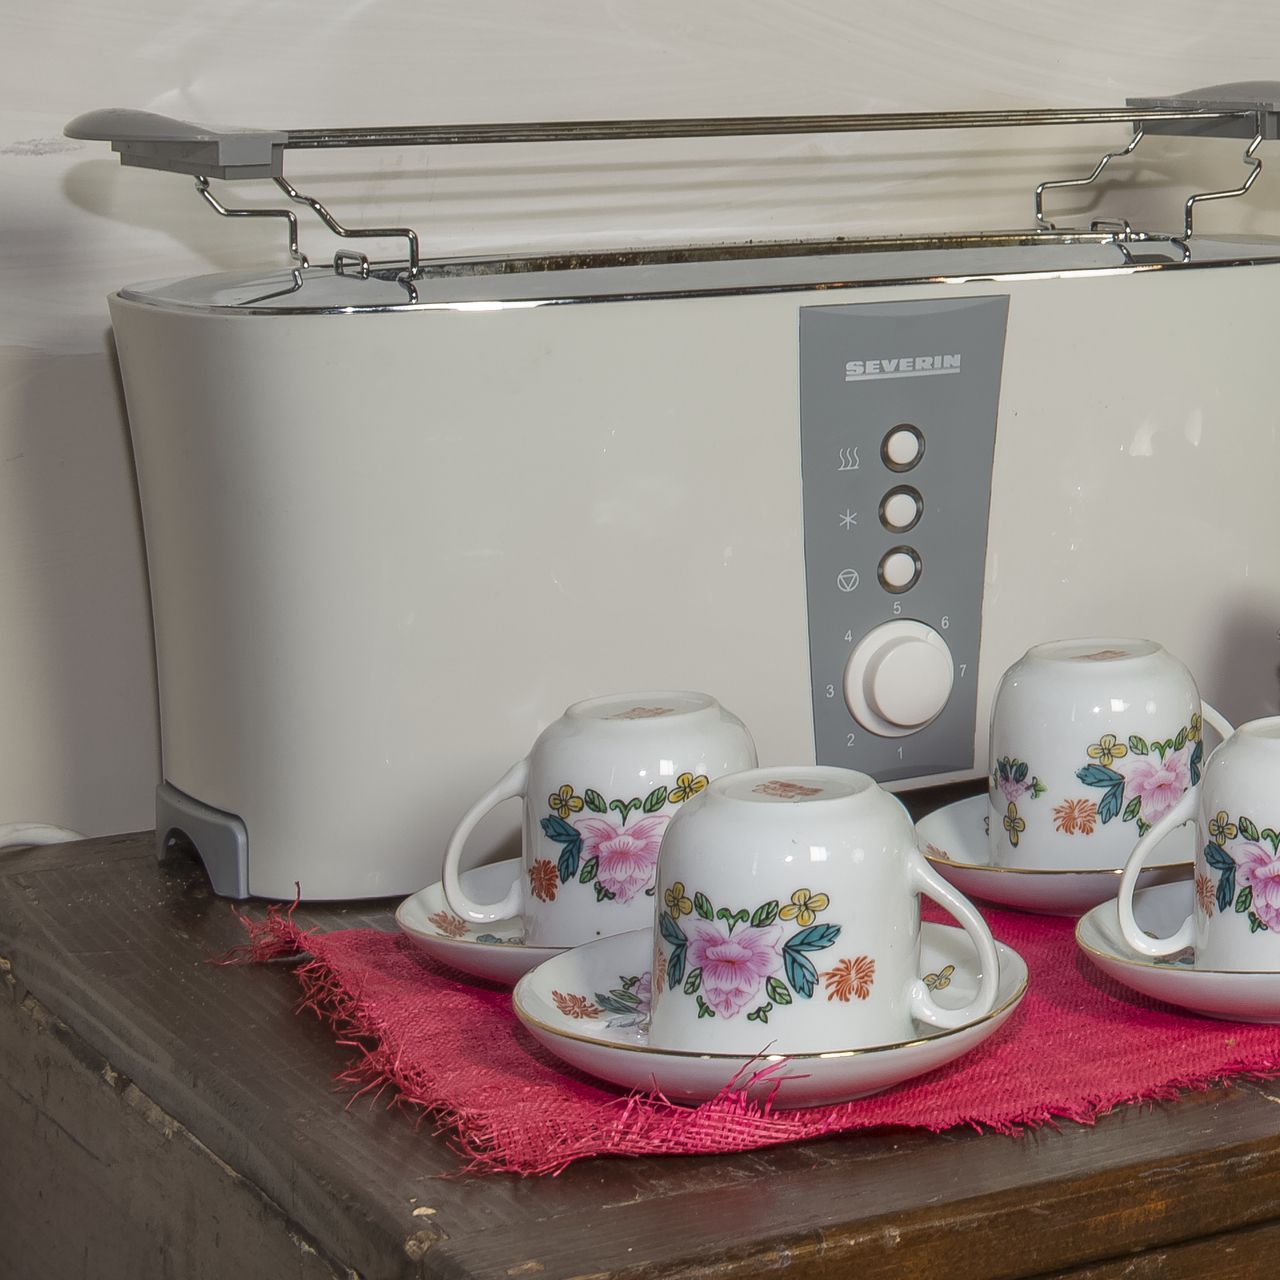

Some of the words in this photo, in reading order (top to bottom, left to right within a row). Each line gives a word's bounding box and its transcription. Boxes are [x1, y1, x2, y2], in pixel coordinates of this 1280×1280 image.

[845, 354, 961, 376] SEVERIN
[893, 601, 902, 615] 5
[941, 616, 949, 629] 6
[844, 629, 853, 643] 4
[959, 664, 967, 677] 7
[826, 684, 835, 698] 3
[847, 733, 855, 747] 2
[897, 747, 904, 760] 1
